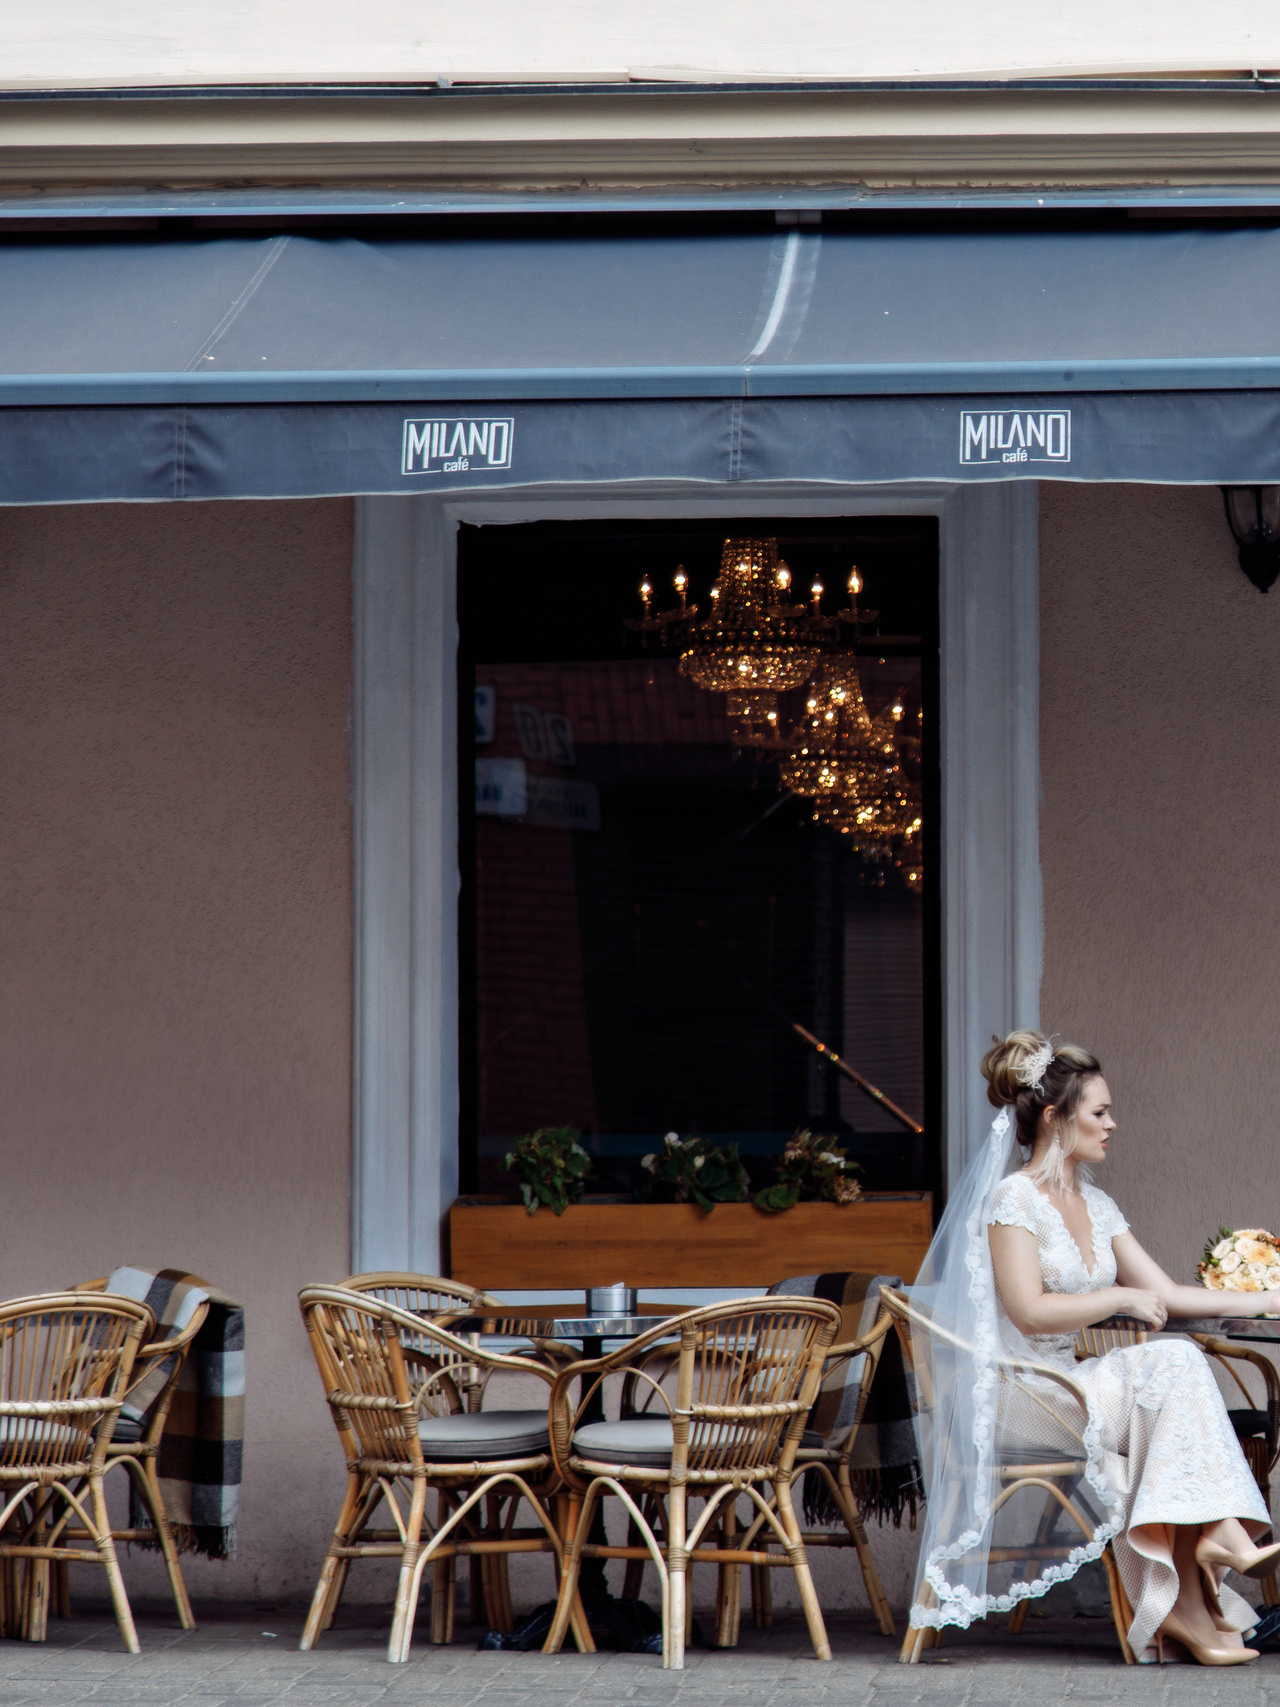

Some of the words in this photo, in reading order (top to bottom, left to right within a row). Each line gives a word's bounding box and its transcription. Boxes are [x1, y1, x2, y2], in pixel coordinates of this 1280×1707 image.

[406, 422, 509, 470] MILANO
[965, 414, 1066, 459] MILANO
[443, 456, 469, 472] café
[1002, 447, 1028, 462] café
